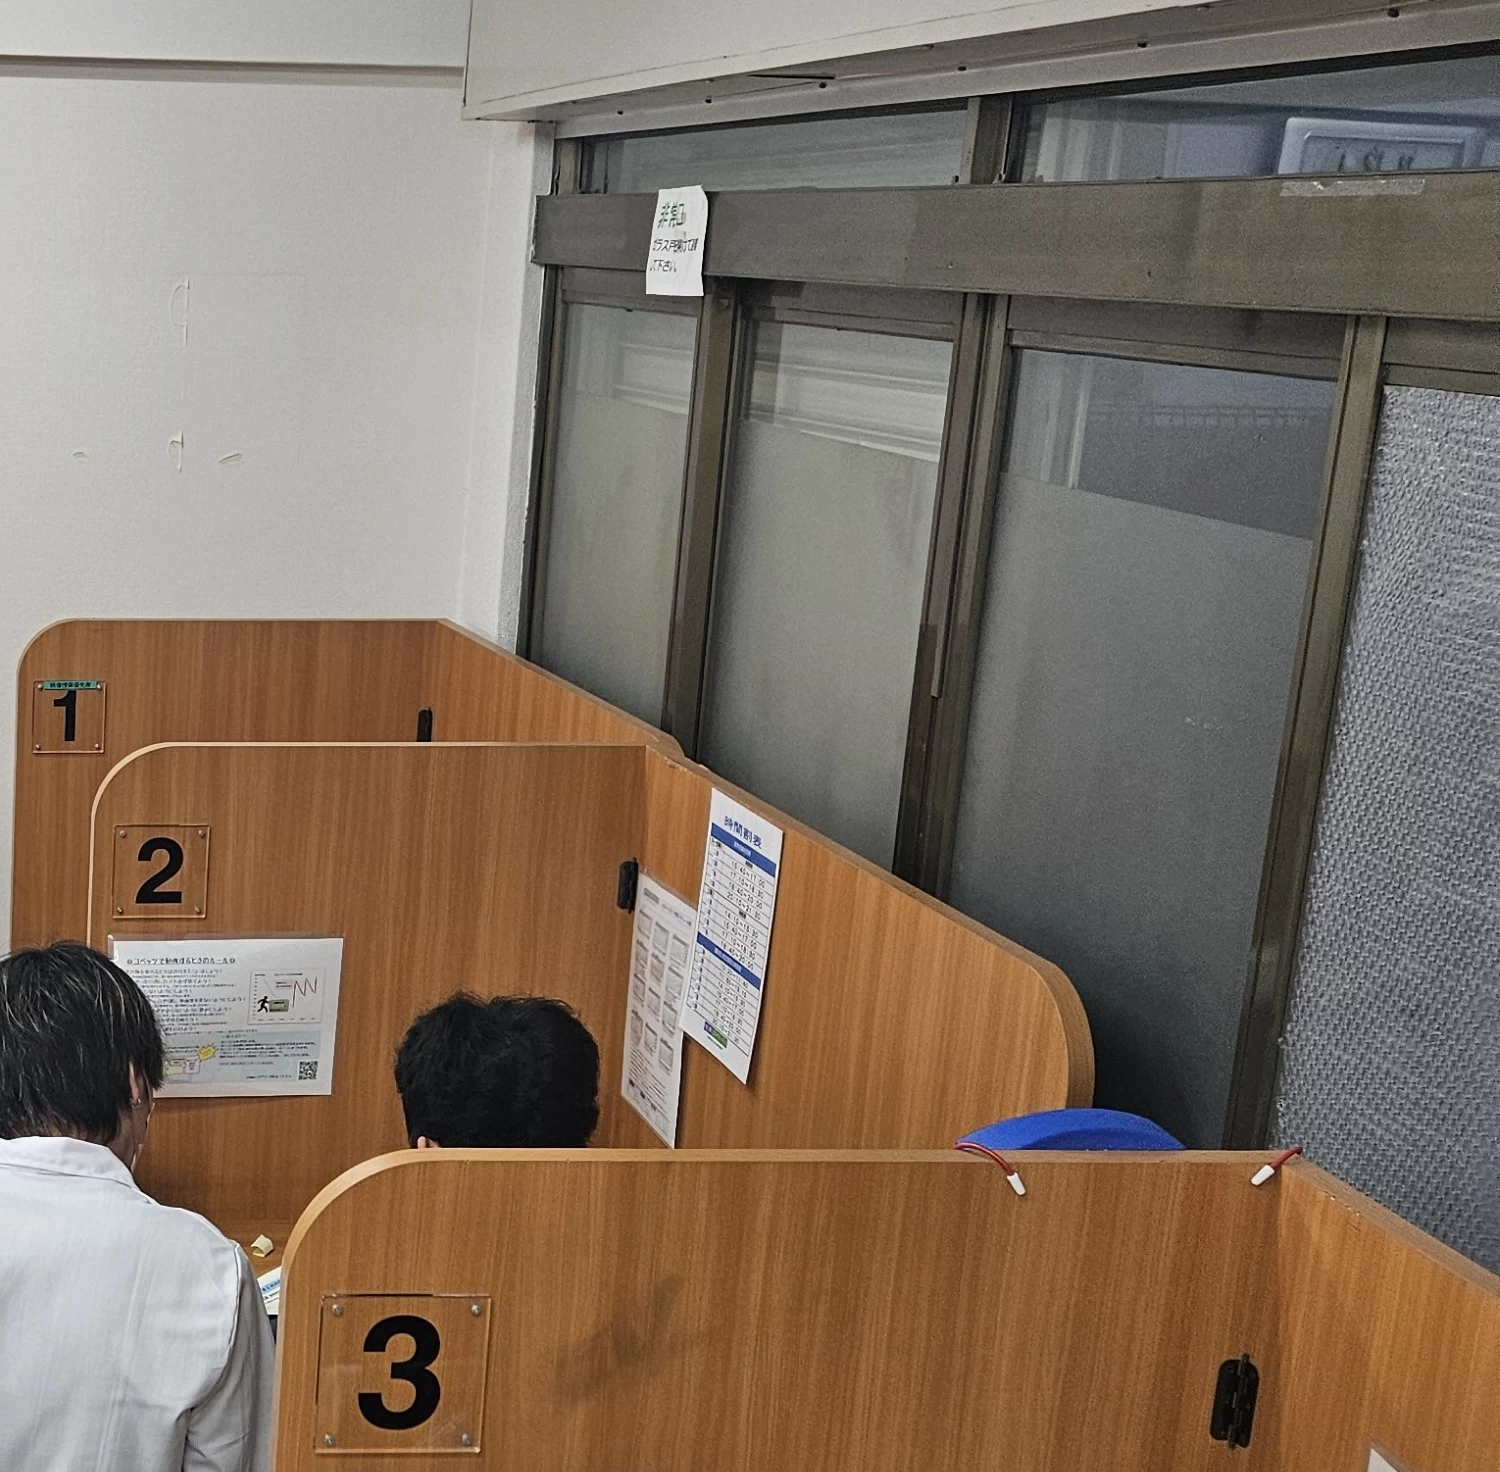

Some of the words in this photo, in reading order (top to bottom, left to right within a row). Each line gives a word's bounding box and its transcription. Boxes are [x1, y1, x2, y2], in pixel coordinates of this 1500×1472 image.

[53, 690, 76, 741] 1
[723, 815, 763, 850] 時間割表
[135, 837, 183, 903] 2
[358, 1315, 440, 1430] 3
